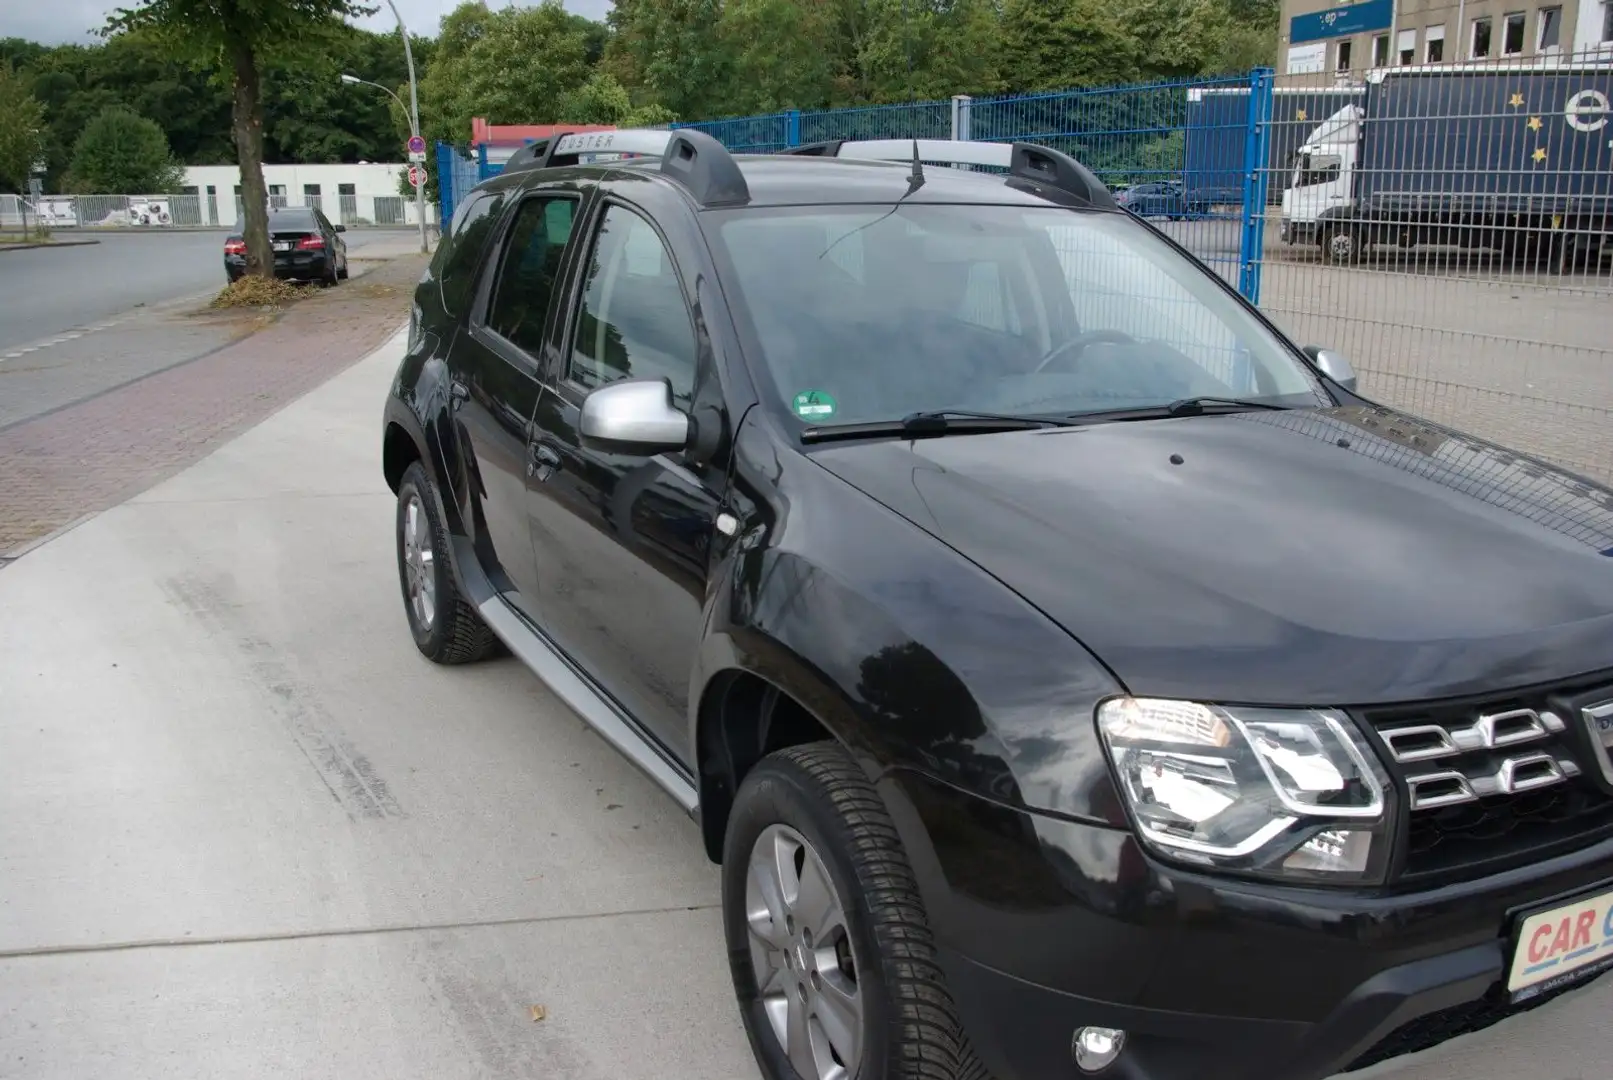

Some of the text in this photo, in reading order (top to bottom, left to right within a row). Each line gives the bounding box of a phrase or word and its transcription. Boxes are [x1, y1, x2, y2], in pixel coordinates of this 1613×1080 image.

[1565, 89, 1610, 132] e
[559, 134, 614, 151] DUSTER
[1528, 909, 1596, 964] CAR
